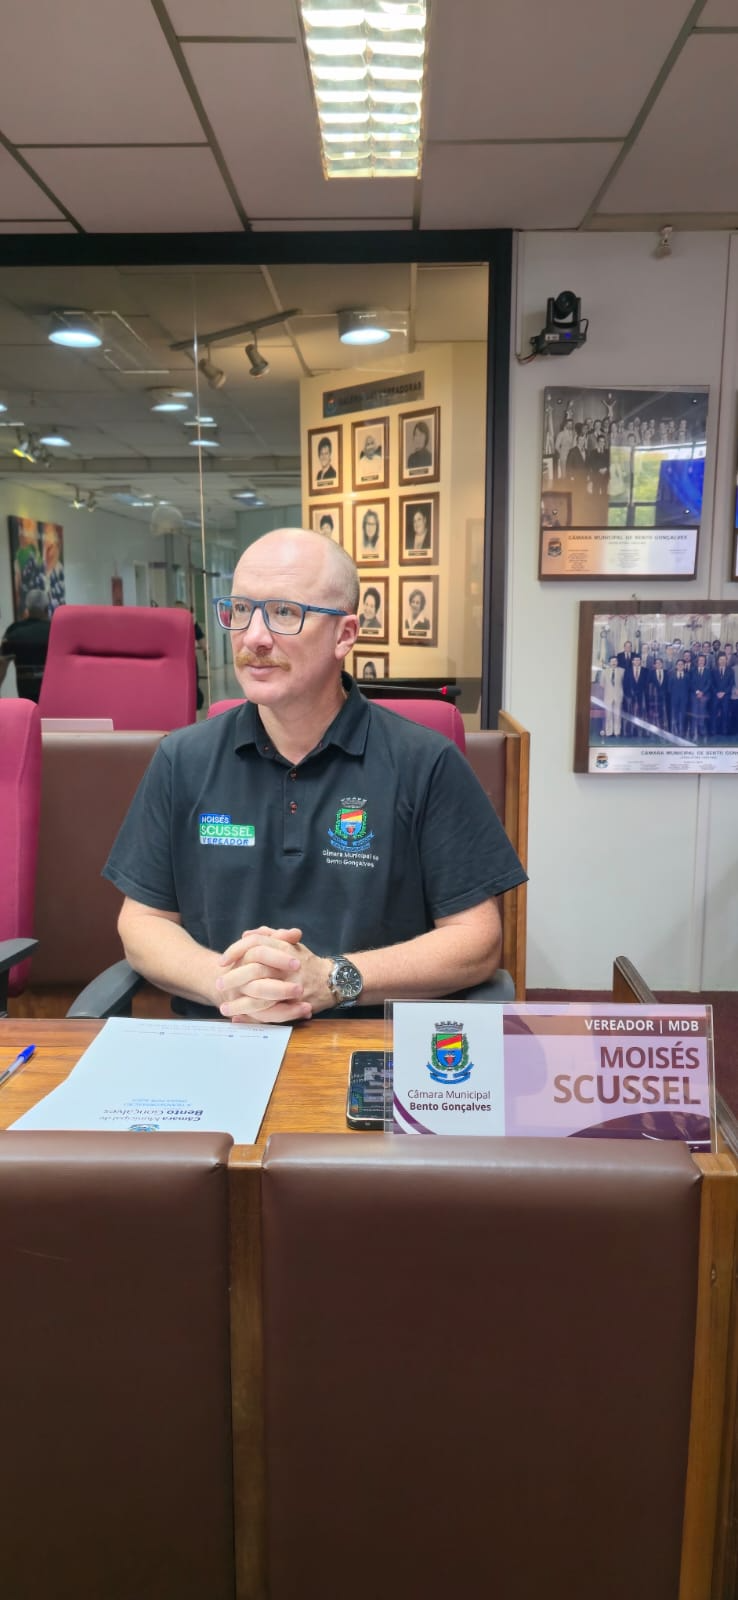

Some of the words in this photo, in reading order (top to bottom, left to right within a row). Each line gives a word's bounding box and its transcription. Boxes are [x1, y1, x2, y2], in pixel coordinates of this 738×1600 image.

[201, 824, 252, 837] SCUSSEL
[202, 836, 249, 846] VEREADOR
[322, 848, 343, 858] Câmara
[344, 851, 372, 861] Municipal
[326, 857, 343, 865] Bento
[343, 858, 375, 868] Gonçalves
[584, 1019, 655, 1032] VEREADOR
[668, 1020, 699, 1032] MDB
[600, 1041, 700, 1070] MOISÉS
[407, 1089, 444, 1100] Câmara
[446, 1089, 491, 1102] Municipal
[553, 1074, 701, 1105] SCUSSEL
[409, 1102, 439, 1111] Bento
[441, 1102, 492, 1114] Gonçalves
